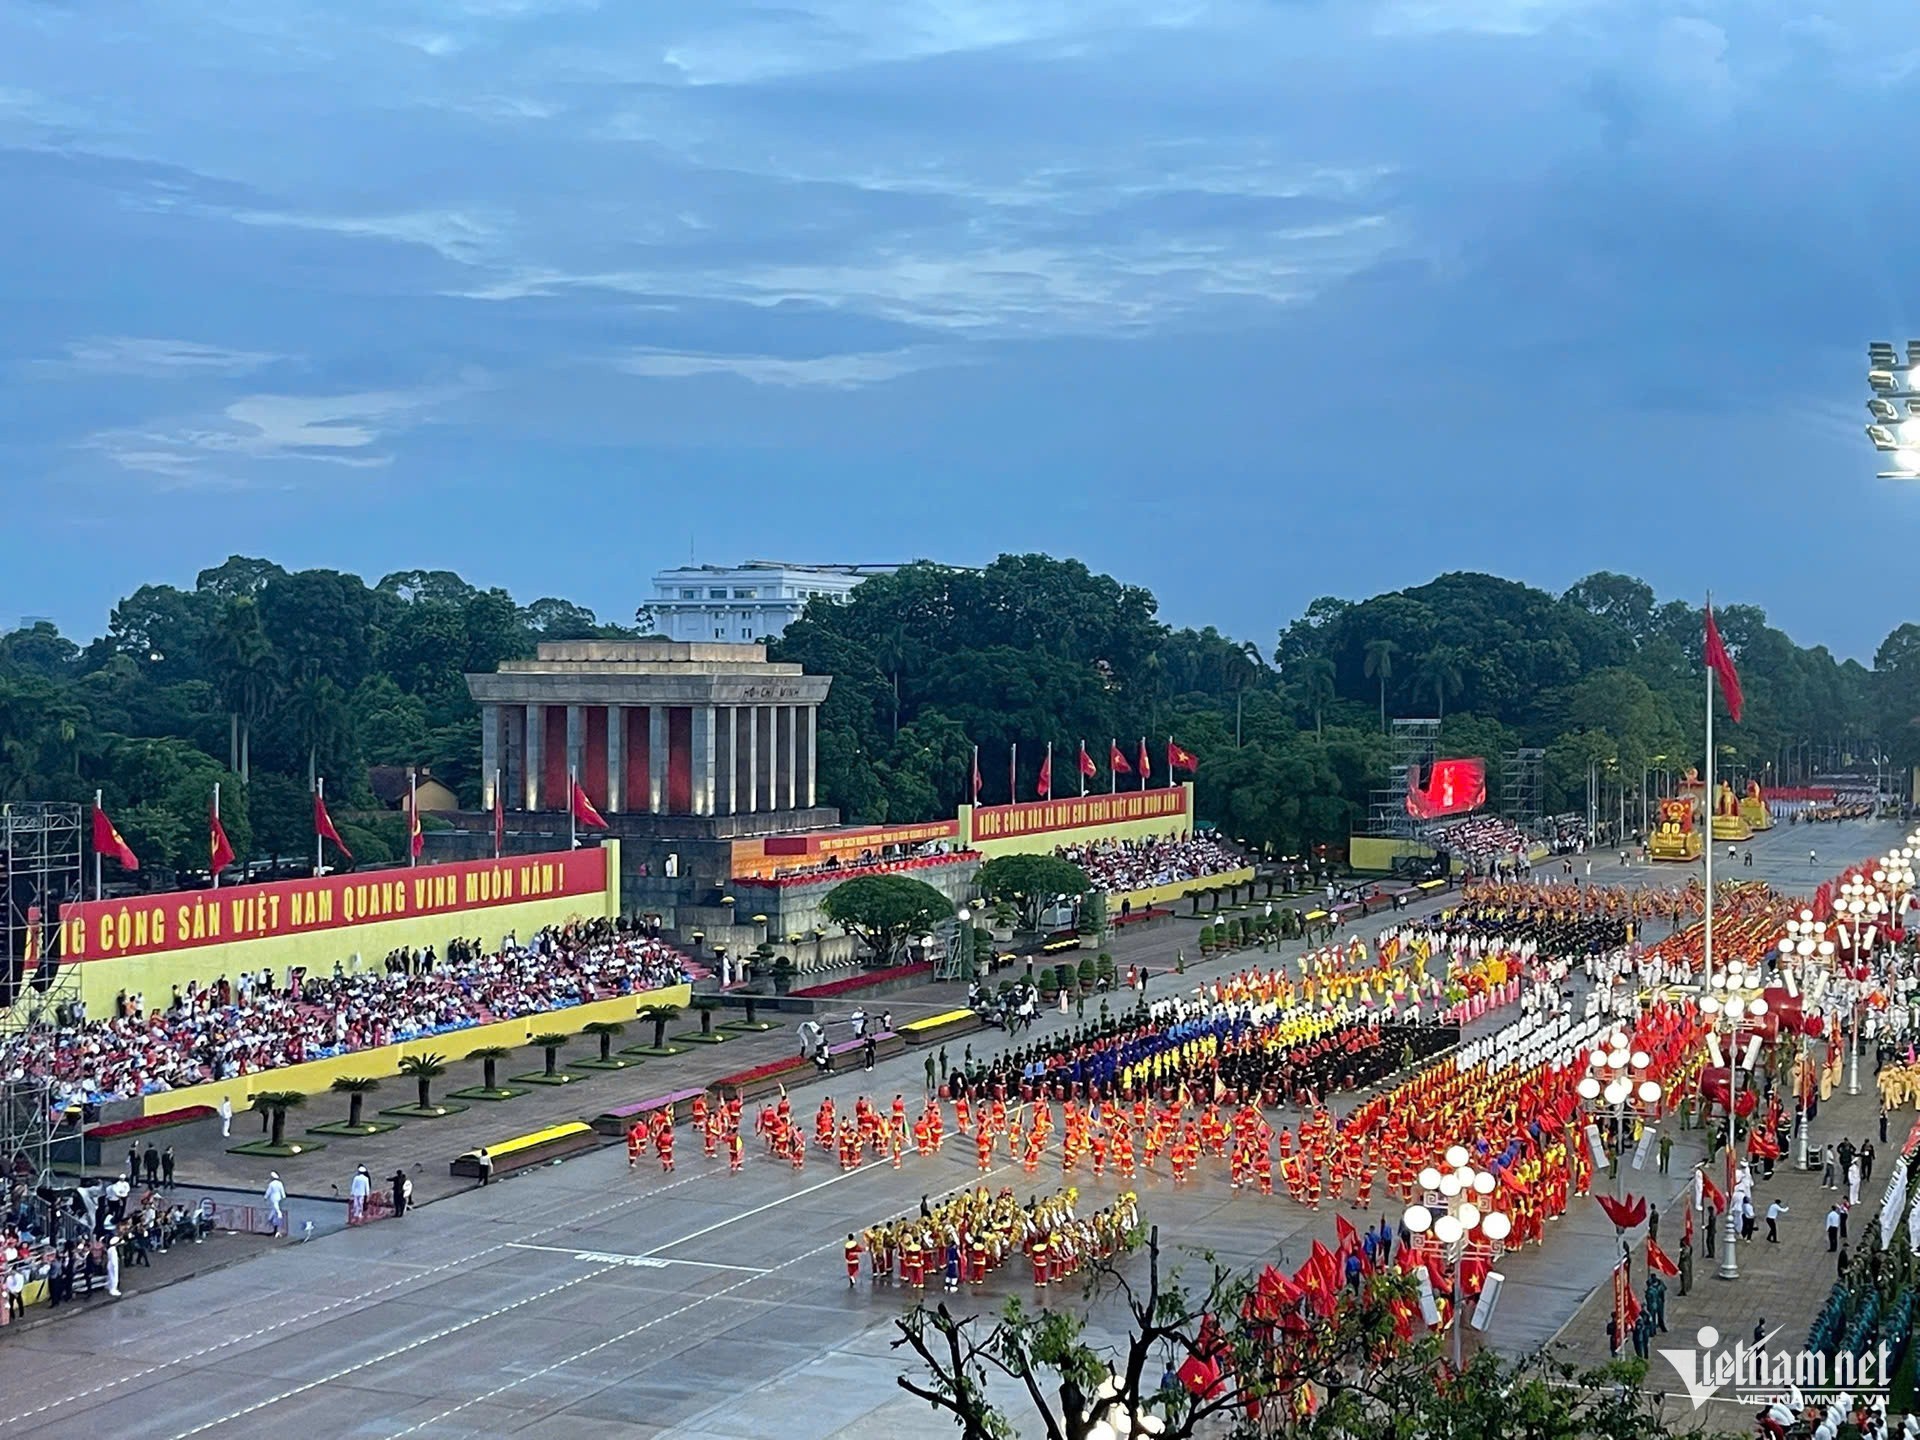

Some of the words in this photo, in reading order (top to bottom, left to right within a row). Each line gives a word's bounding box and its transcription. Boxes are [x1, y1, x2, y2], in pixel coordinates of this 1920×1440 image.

[101, 907, 165, 955] CỘNG
[178, 896, 221, 941] SẢN
[232, 891, 280, 937] VIỆT
[291, 889, 333, 926] NAM
[343, 880, 406, 922] QUANG
[415, 875, 457, 910] VINH
[466, 865, 513, 903] MUÔN
[520, 861, 554, 897] NĂM
